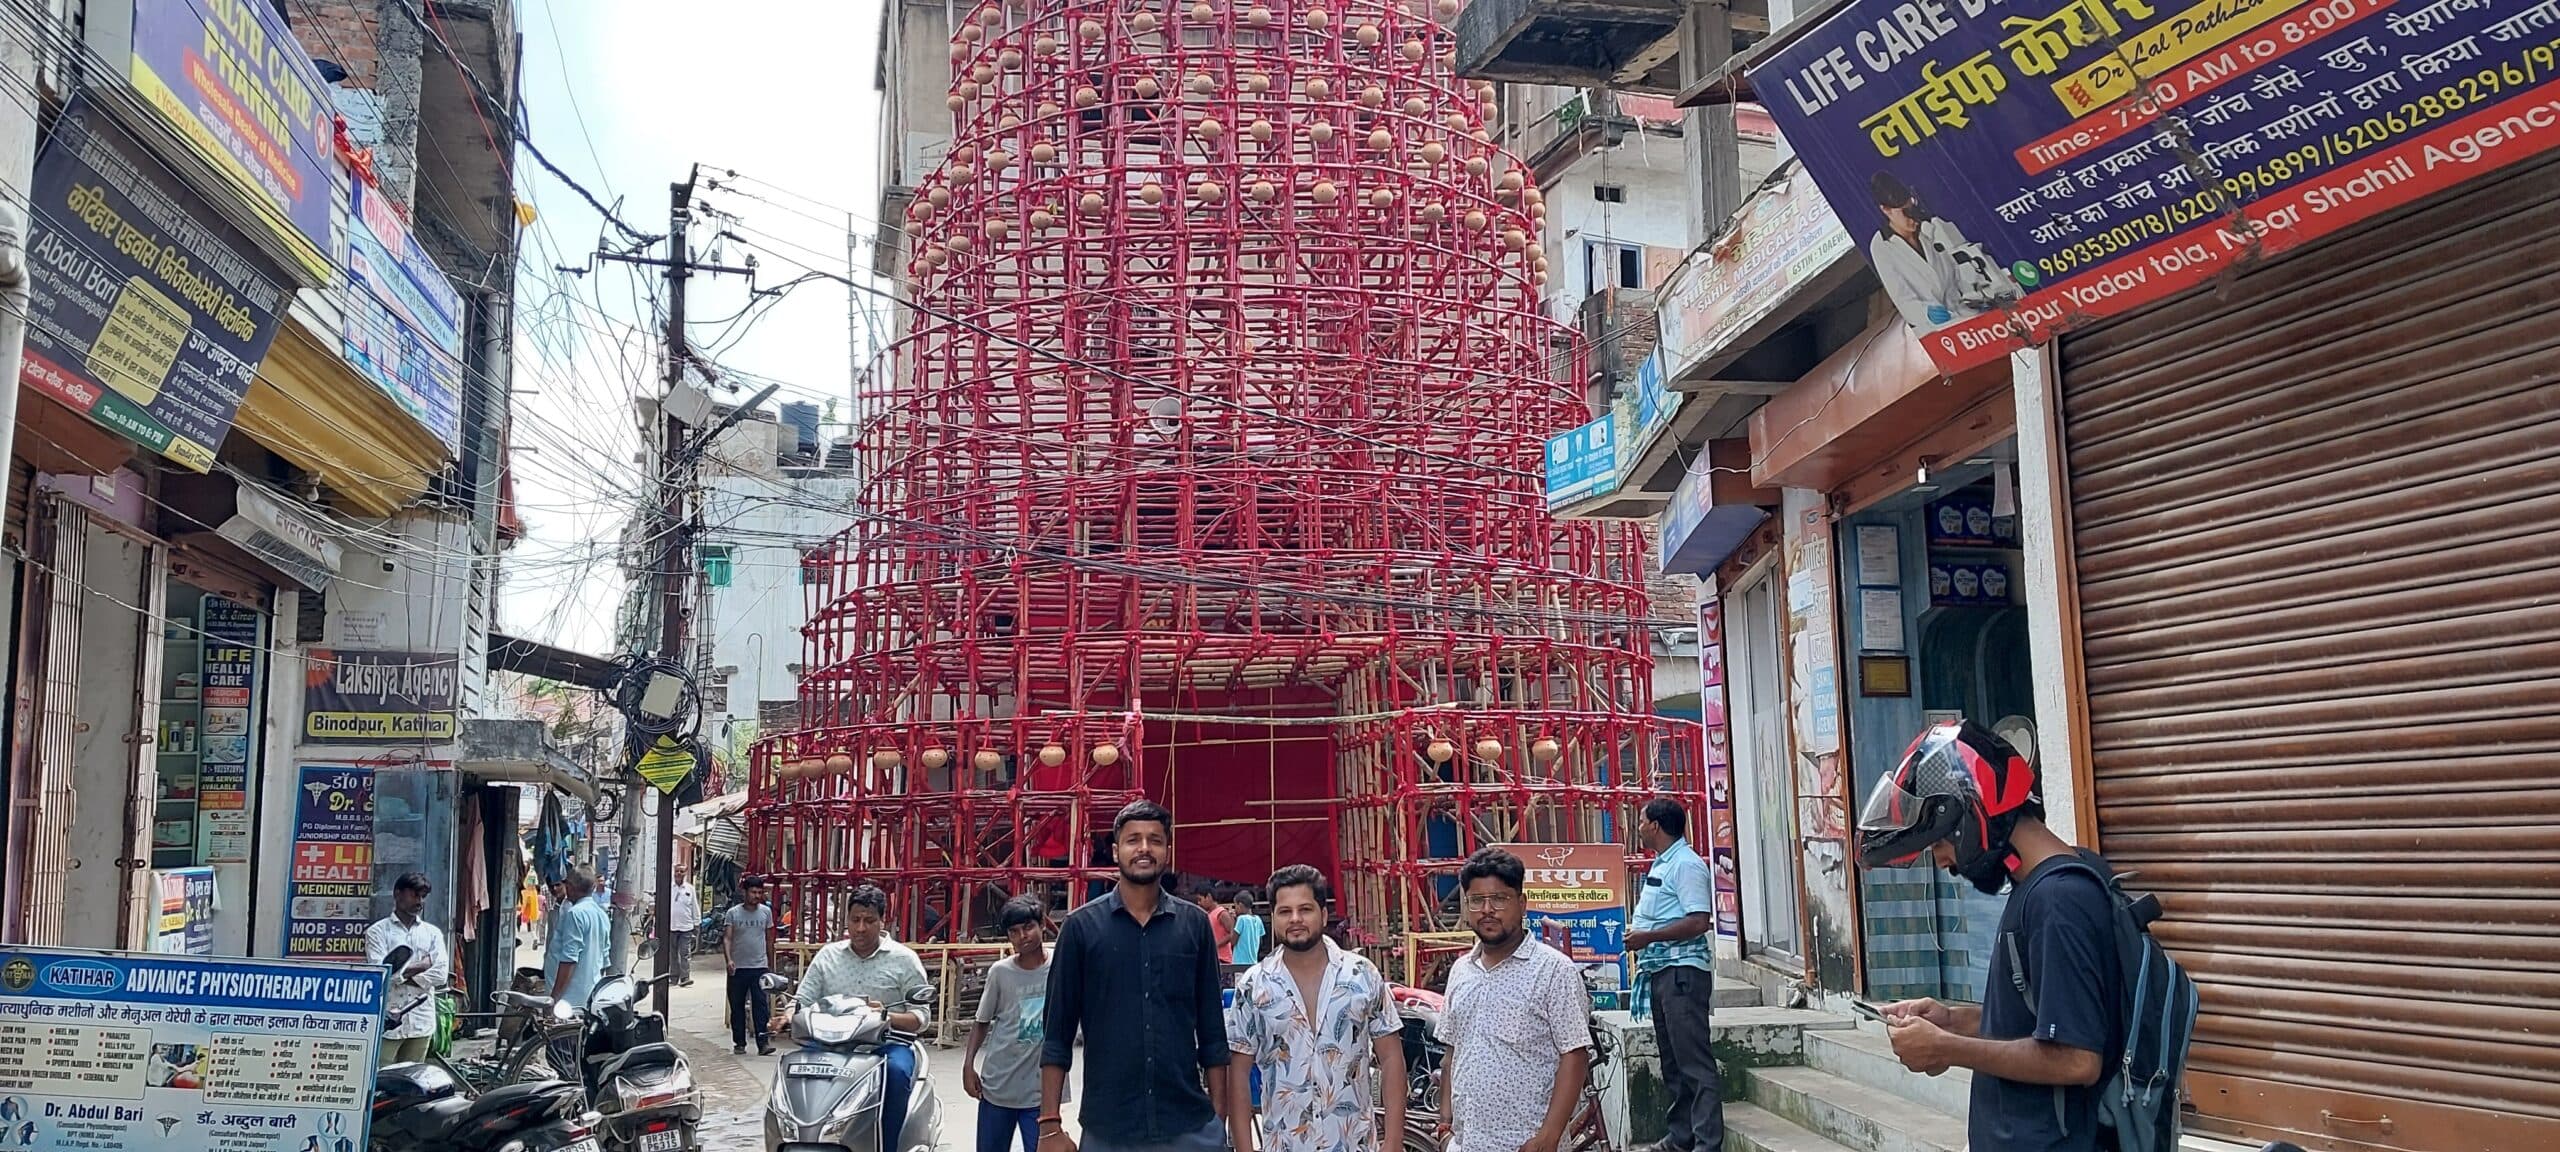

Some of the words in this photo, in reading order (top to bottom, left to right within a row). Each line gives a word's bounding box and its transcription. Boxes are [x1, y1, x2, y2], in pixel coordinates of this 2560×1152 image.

[1784, 46, 1865, 117] LIFE
[1856, 0, 1958, 73] CARE
[2087, 64, 2125, 89] Dr
[2131, 33, 2170, 66] Lal
[203, 16, 293, 158] PHARMA
[268, 46, 312, 132] CARE
[1858, 50, 2007, 157] लाईफ
[2029, 126, 2107, 166] Time:-
[2186, 53, 2239, 93] AM
[2240, 38, 2277, 63] to
[2281, 2, 2356, 44] 8:00
[2075, 201, 2109, 224] का
[2104, 182, 2157, 211] जाँच
[2257, 90, 2344, 141] मशीनों
[2343, 70, 2402, 110] द्वारा
[2400, 35, 2482, 82] किया
[1995, 187, 2042, 223] हमारे
[2037, 170, 2077, 201] यहाँ
[2072, 164, 2104, 189] हर
[2097, 139, 2160, 178] प्रकार
[2192, 94, 2253, 127] जाँच
[67, 183, 122, 239] कटिहार
[34, 231, 90, 283] Abdul
[84, 265, 120, 305] Bari
[1697, 279, 1732, 313] SAHIL
[1732, 229, 1795, 283] MEDICAL
[1798, 200, 1831, 235] AGE
[1959, 298, 2065, 352] Binodpur
[2062, 264, 2148, 308] Yadav
[2148, 241, 2218, 278] tola,
[2215, 201, 2300, 252] Near
[2303, 155, 2416, 215] Shahil
[205, 648, 252, 662] LIFE
[205, 663, 251, 675] HEALTH
[210, 675, 244, 686] CARE
[335, 655, 399, 706] Lakshya
[401, 656, 457, 707] Agency
[313, 714, 387, 734] Binodpur,
[391, 715, 448, 732] Katihar
[329, 791, 356, 812] Dr.
[314, 823, 342, 831] Diploma
[298, 884, 354, 896] MEDICINE
[290, 937, 322, 953] HOME
[325, 937, 366, 953] SERVIC
[292, 922, 328, 935] MOB
[50, 966, 116, 987] KATIHAR
[126, 967, 197, 995] ADVANCE
[199, 971, 321, 1001] PHYSIOTHERAPY
[323, 975, 373, 1004] CLINIC
[58, 1002, 95, 1019] मशीनों
[97, 1003, 118, 1020] और
[121, 1004, 162, 1025] मेनुअल
[165, 1007, 192, 1024] थेरेपी
[194, 1008, 206, 1024] के
[209, 1012, 229, 1027] द्वारा
[233, 1013, 264, 1027] सफल
[268, 1016, 300, 1030] इलाज
[302, 1013, 329, 1031] किया
[333, 1019, 357, 1033] जाता
[360, 1016, 368, 1033] है
[45, 1102, 63, 1117] Dr.
[68, 1103, 109, 1120] Abdul
[114, 1106, 144, 1121] Bari
[221, 1113, 265, 1130] अब्दुल
[269, 1113, 297, 1129] बारी
